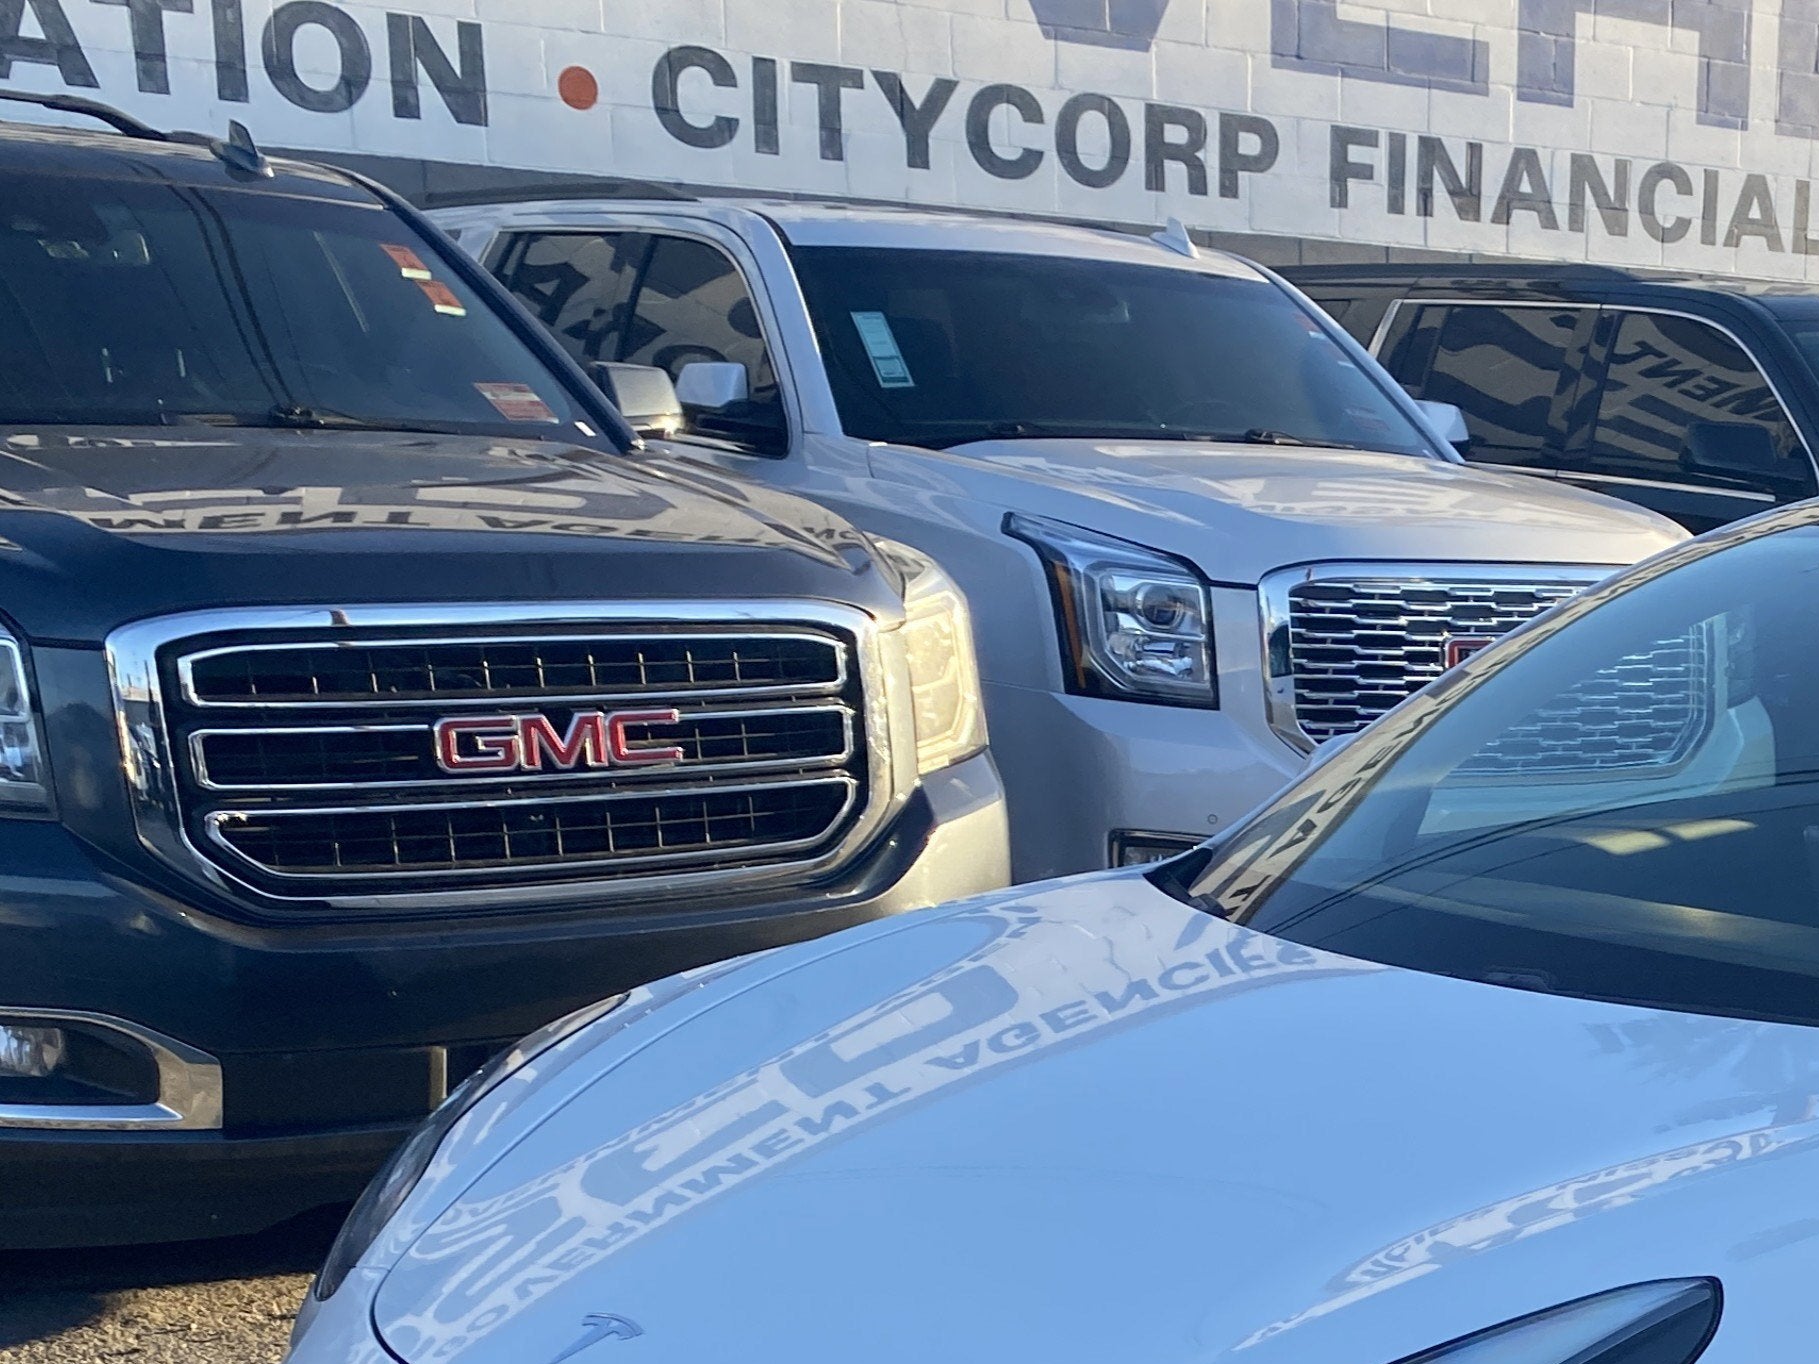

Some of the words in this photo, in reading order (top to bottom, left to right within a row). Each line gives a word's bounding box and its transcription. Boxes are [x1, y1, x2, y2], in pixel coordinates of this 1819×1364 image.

[0, 0, 488, 127] ATION
[652, 45, 1281, 200] CITYCORP
[433, 708, 684, 775] GMC
